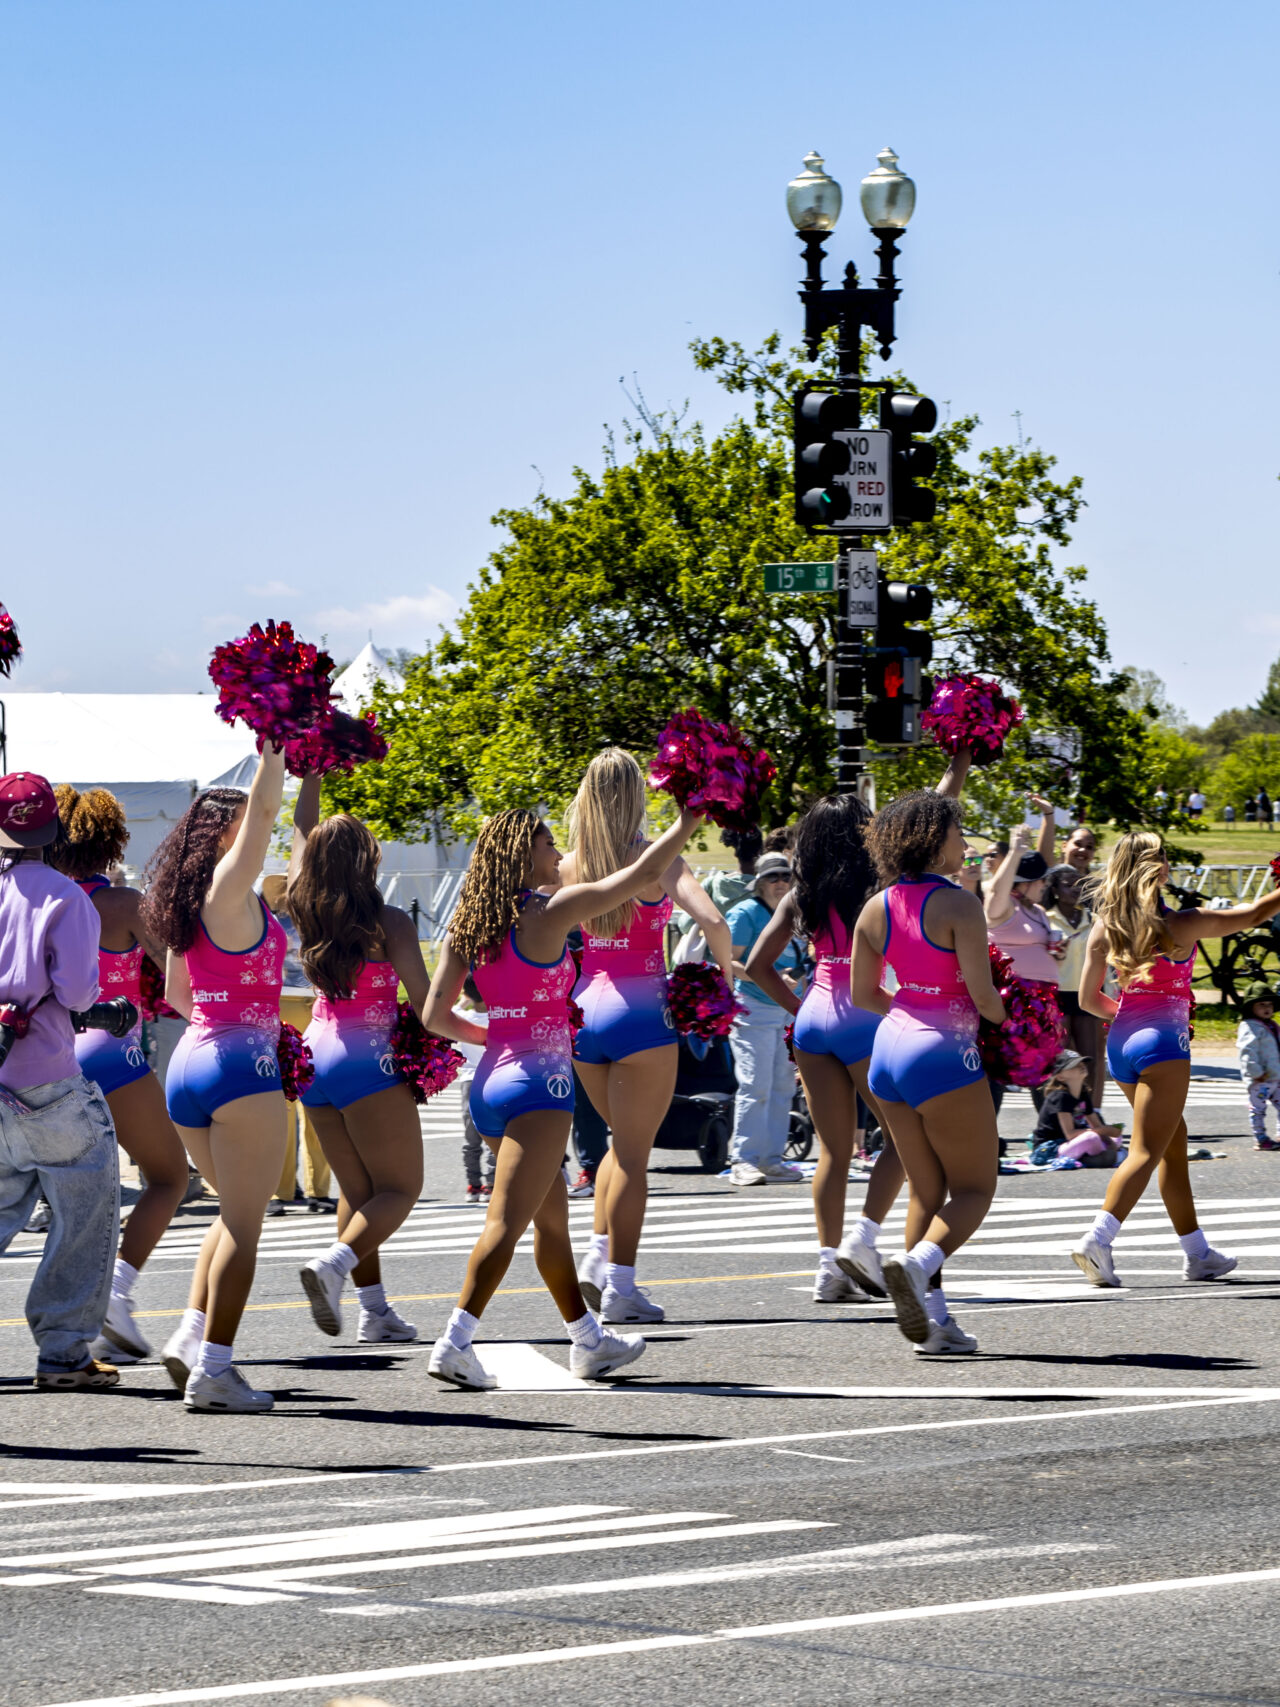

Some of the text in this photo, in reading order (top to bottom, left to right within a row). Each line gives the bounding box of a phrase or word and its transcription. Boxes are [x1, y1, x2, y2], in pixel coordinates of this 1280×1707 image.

[847, 437, 869, 455] NO
[848, 461, 877, 475] URN
[857, 481, 885, 495] RED
[850, 503, 883, 517] ROW
